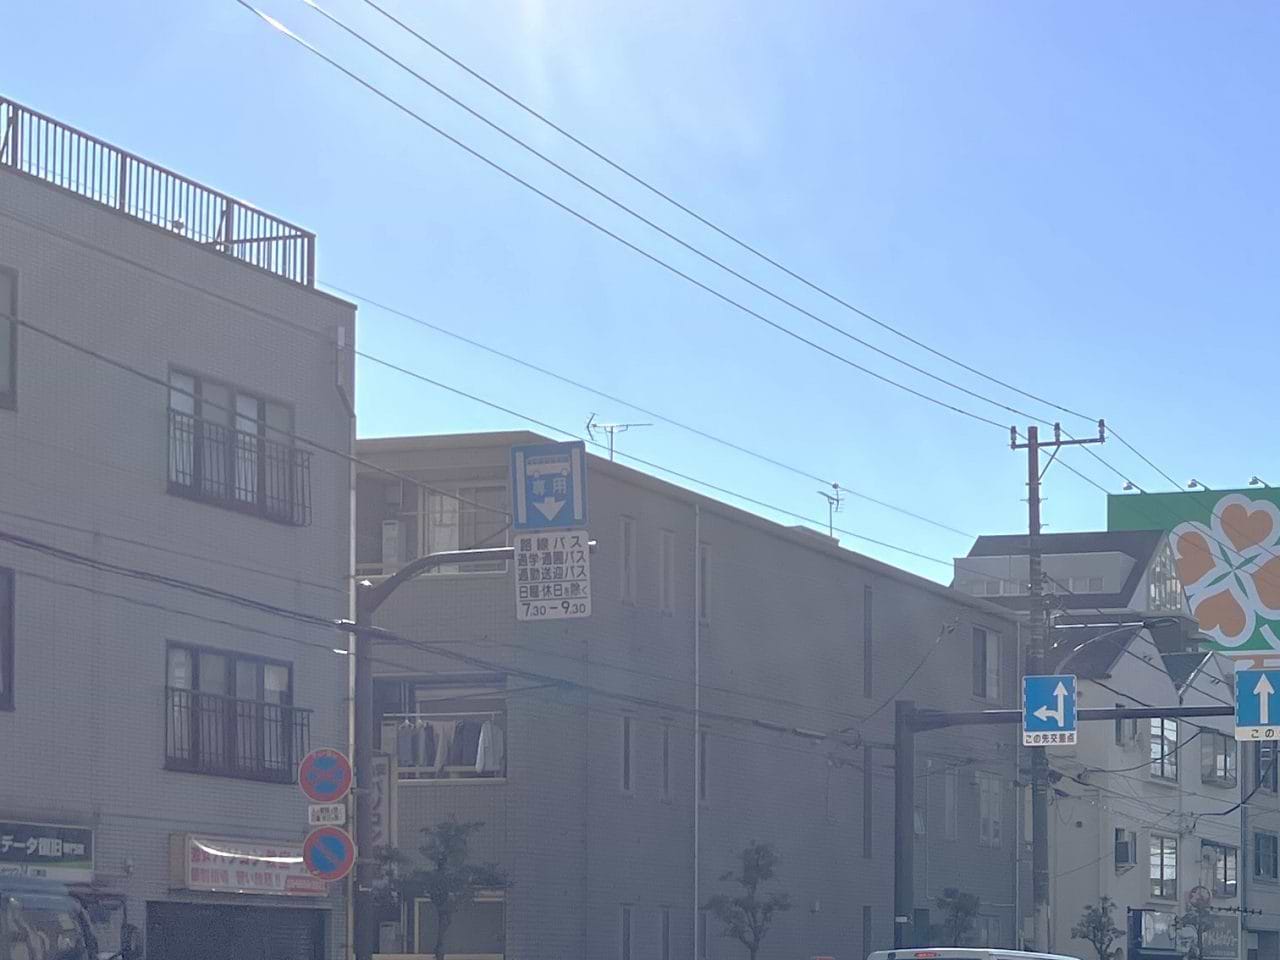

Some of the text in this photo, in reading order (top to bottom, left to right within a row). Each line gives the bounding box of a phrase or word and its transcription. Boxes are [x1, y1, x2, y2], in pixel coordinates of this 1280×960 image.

[520, 535, 583, 552] 路線バス
[517, 565, 588, 582] 通勤送迎バス
[1025, 733, 1075, 744] この先交差点
